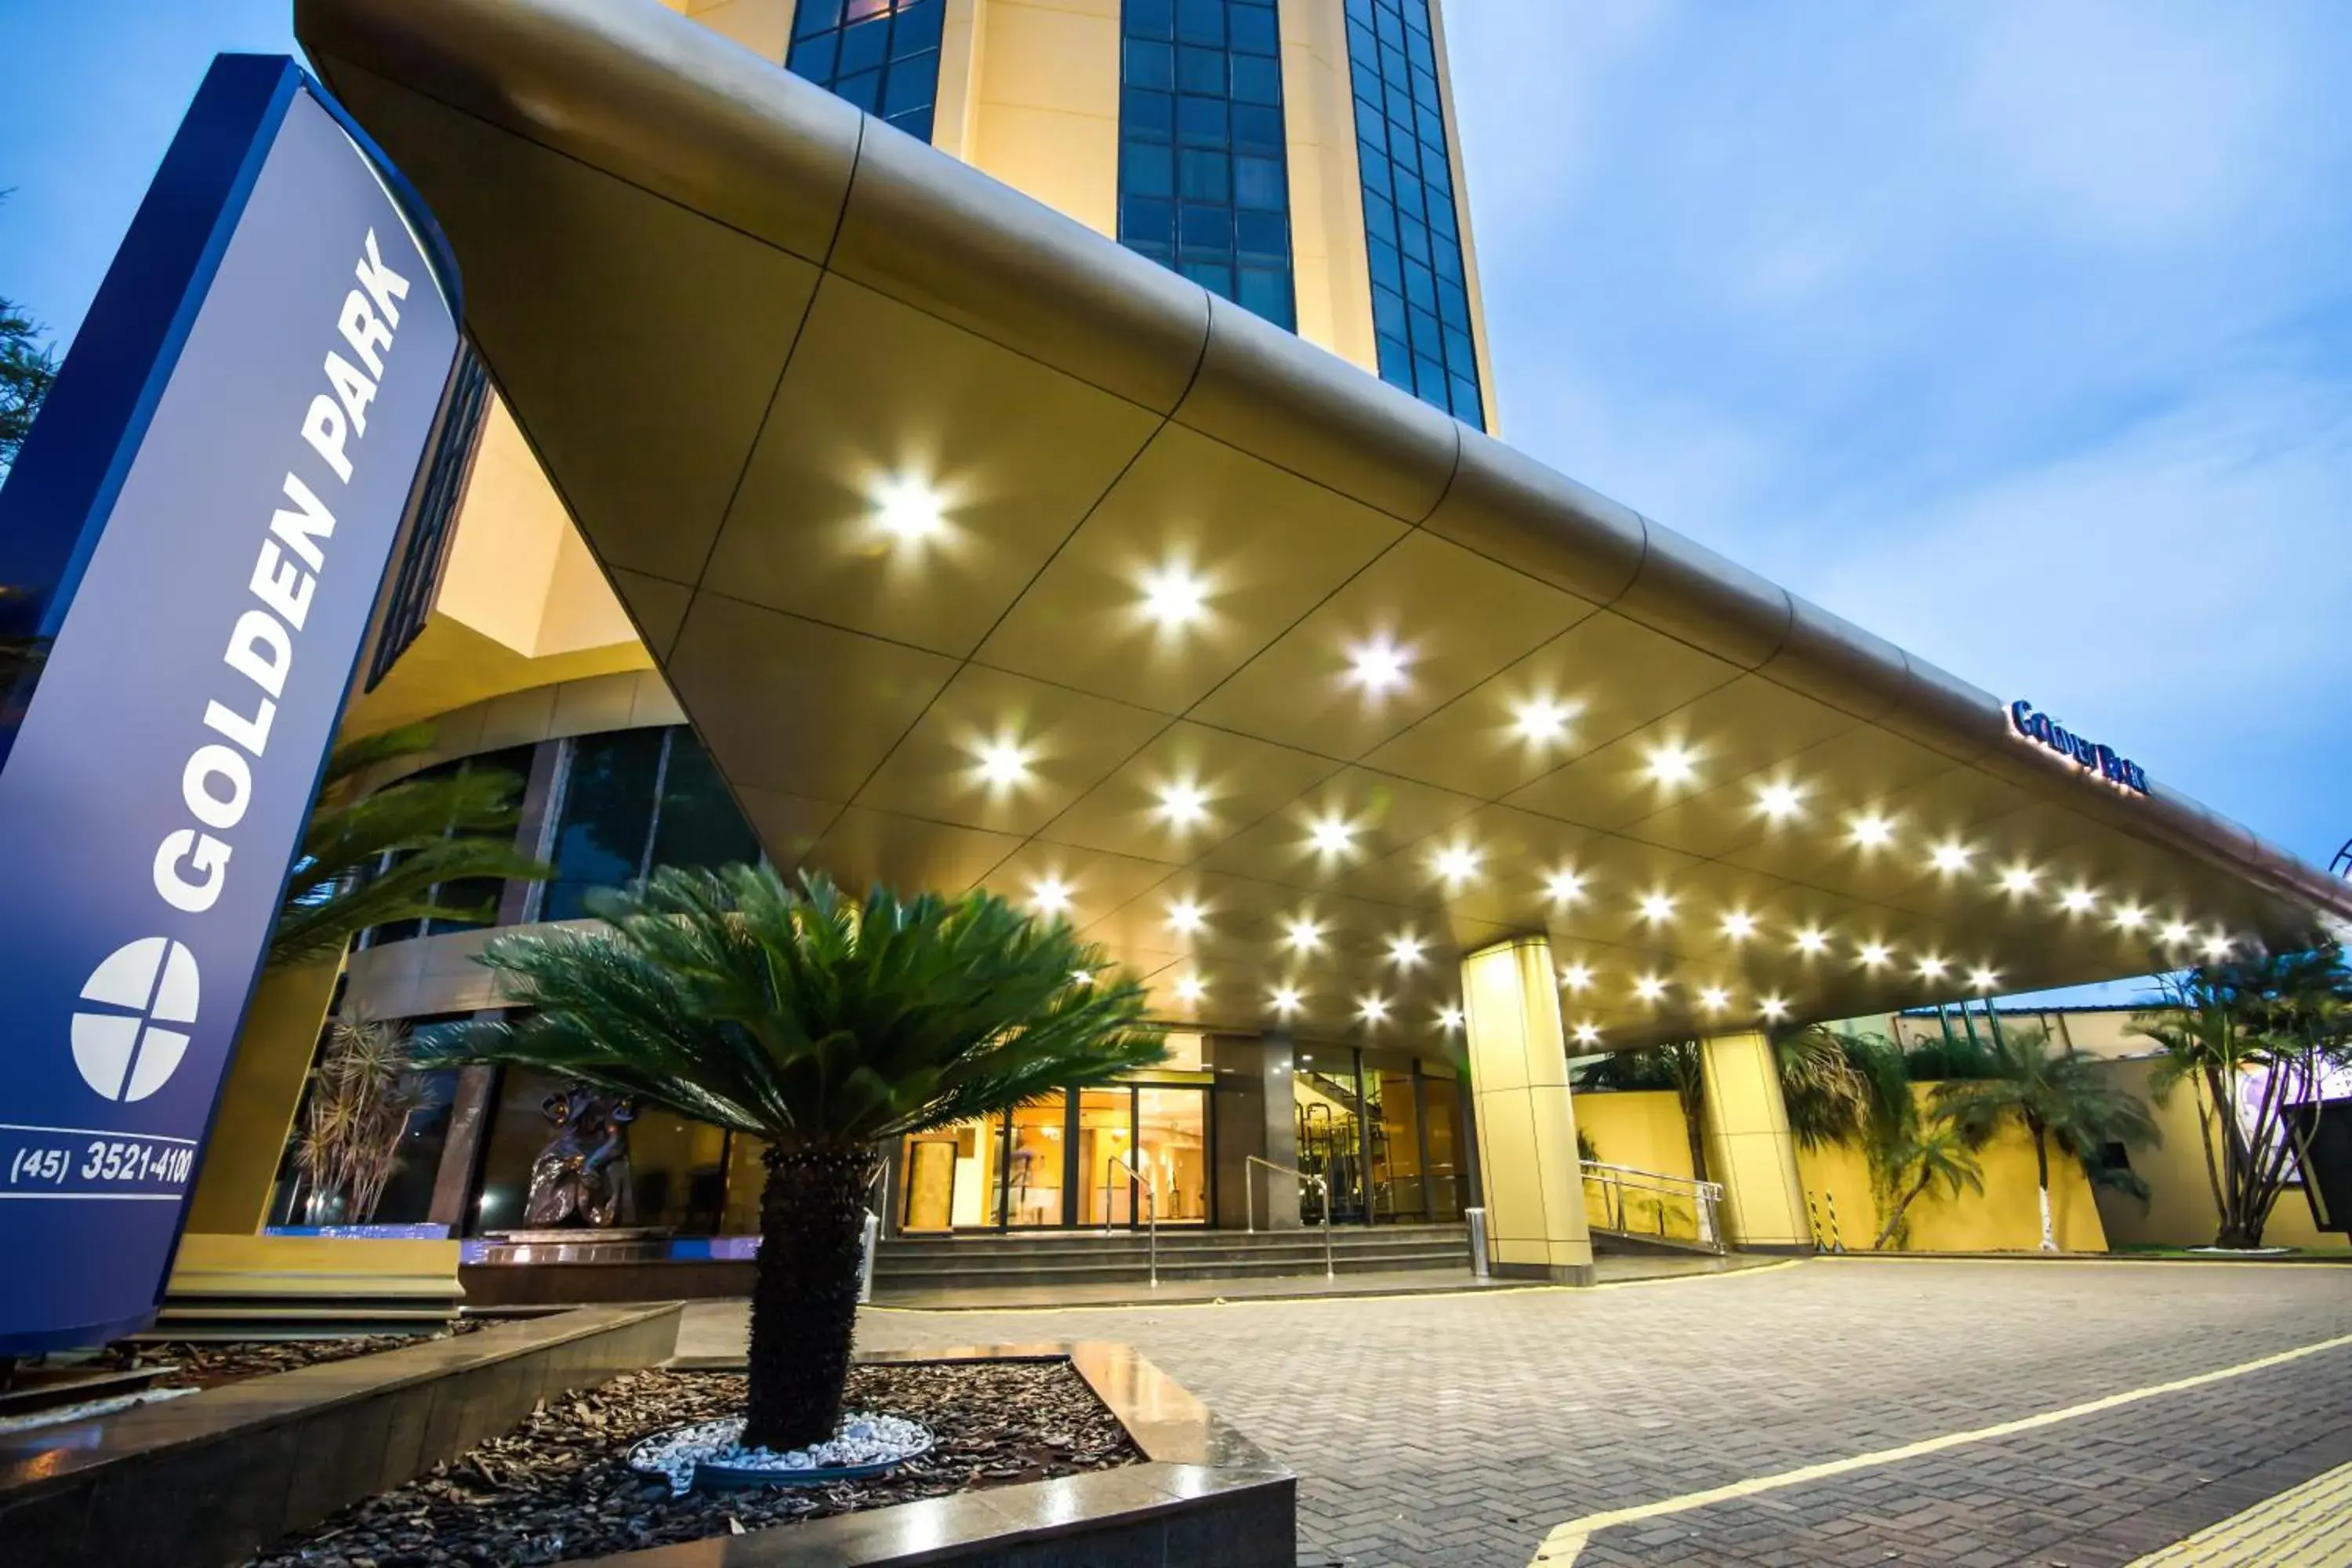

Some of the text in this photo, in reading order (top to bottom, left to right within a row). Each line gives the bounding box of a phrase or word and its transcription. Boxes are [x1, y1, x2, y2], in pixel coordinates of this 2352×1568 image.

[153, 227, 410, 913] GOLDEN PARK
[10, 1142, 193, 1185] (45) 3521-4100
